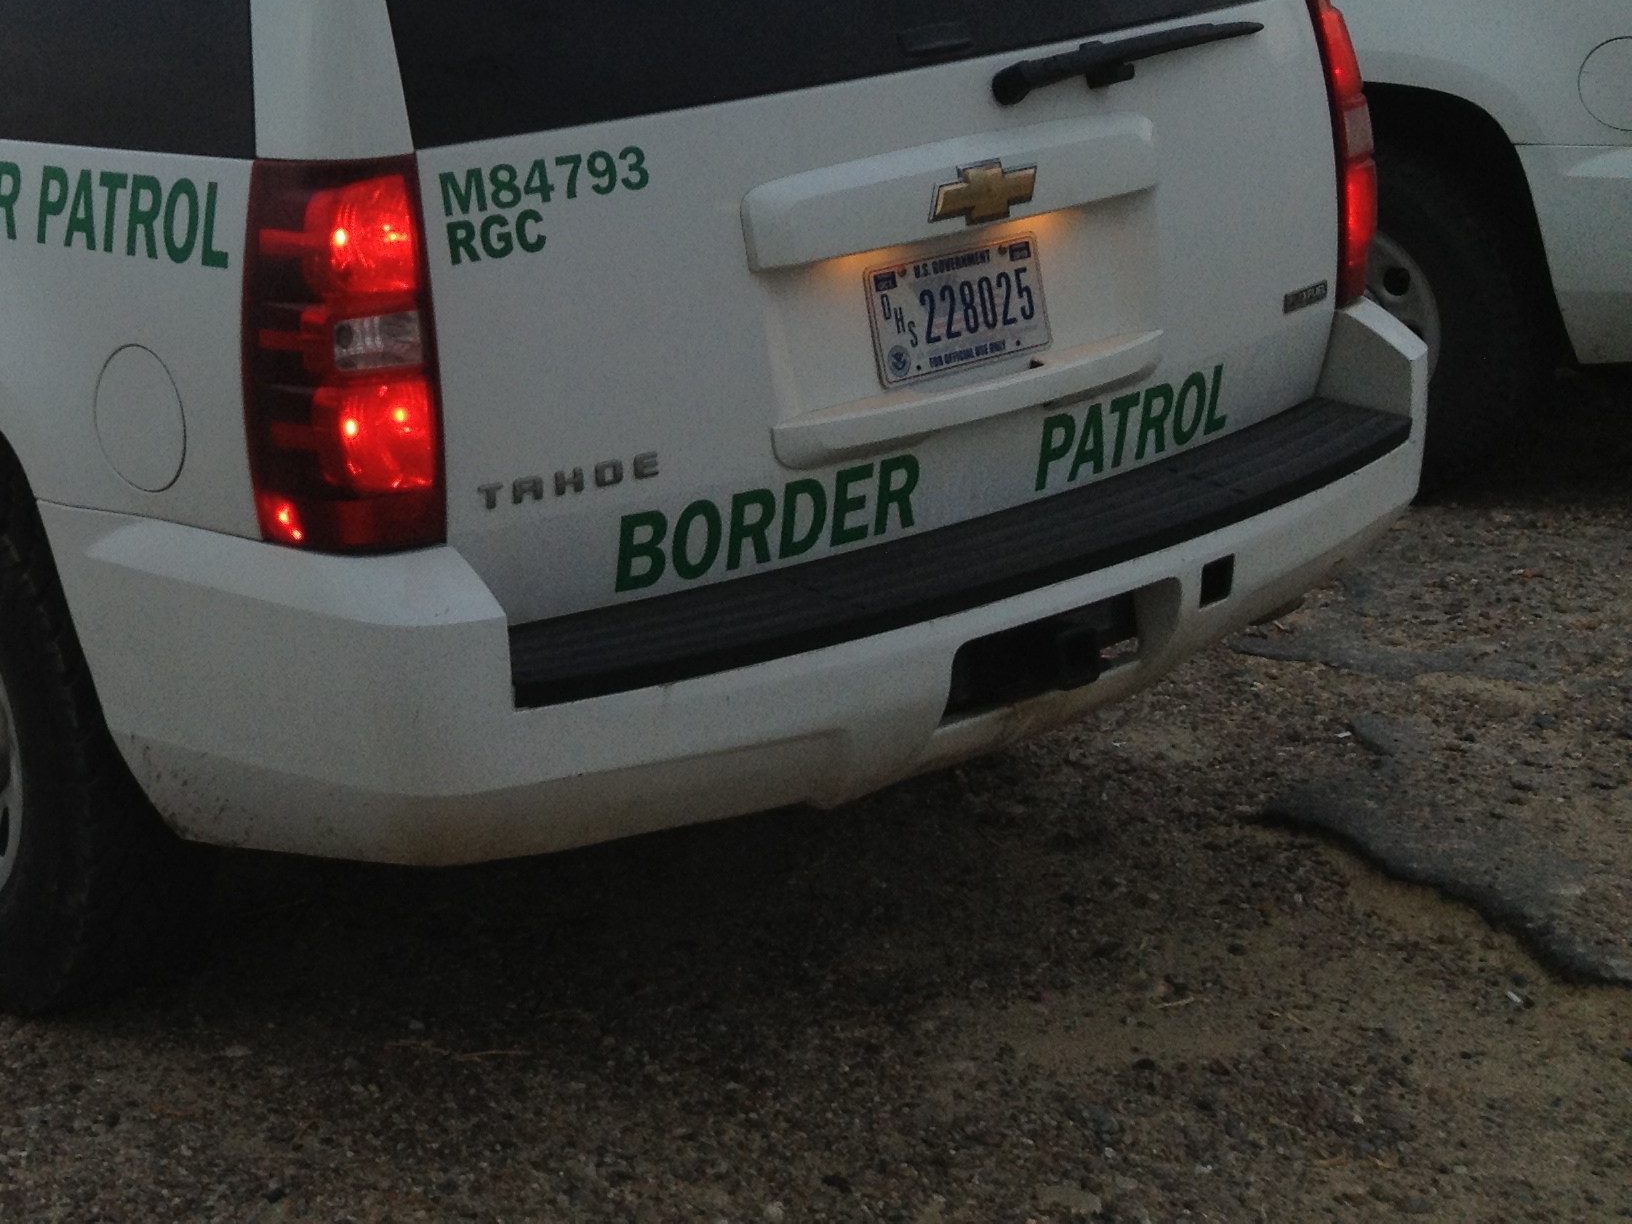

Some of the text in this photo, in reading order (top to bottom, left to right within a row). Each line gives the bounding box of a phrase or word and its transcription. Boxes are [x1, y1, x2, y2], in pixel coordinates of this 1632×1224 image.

[37, 165, 230, 269] PATROL
[439, 146, 651, 217] M84793
[446, 209, 548, 266] RGC
[913, 262, 931, 278] U.S.
[932, 249, 990, 275] GOVERNMENT
[919, 267, 1035, 344] 228025
[477, 450, 660, 511] TAHOE
[614, 363, 1228, 593] BORDER PATROL
